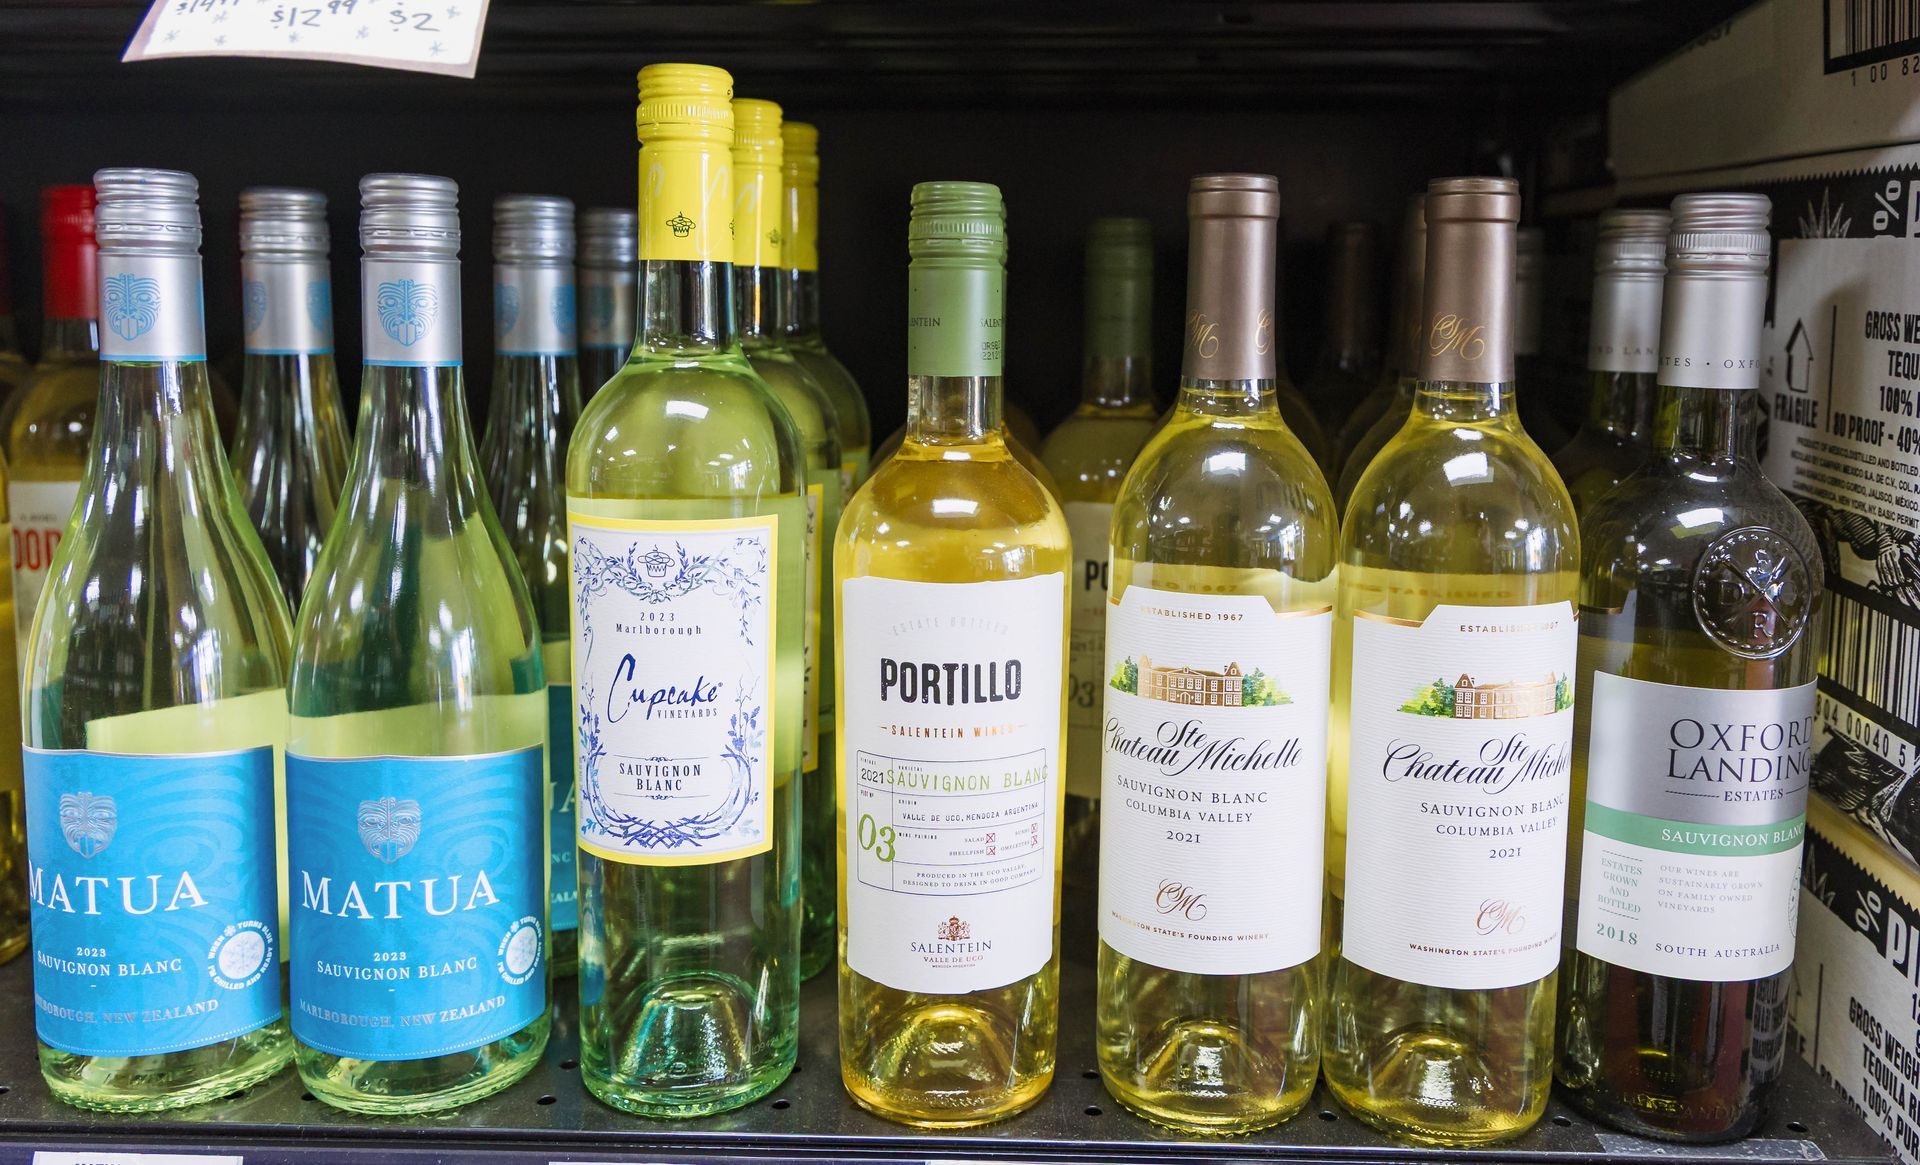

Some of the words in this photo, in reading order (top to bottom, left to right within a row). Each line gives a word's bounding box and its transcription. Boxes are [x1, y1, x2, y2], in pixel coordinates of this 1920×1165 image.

[1865, 310, 1901, 341] GROSS
[1775, 393, 1818, 428] FRAGILE
[1880, 386, 1912, 417] 100%
[1848, 415, 1885, 447] PROOF
[1878, 458, 1890, 469] AND
[1890, 460, 1918, 477] BOTTLED
[1876, 474, 1884, 485] DE
[1878, 507, 1895, 521] BASIC
[1896, 510, 1920, 530] PERMIT
[640, 612, 675, 621] 2023
[616, 624, 702, 635] Marlborough
[881, 658, 1021, 706] PORTILLO
[657, 708, 718, 719] VINEYARDS
[891, 725, 964, 738] SALENTEIN
[1104, 712, 1180, 766] Chateau
[1157, 719, 1207, 749] Ste
[1670, 716, 1812, 753] OXFORD
[1846, 711, 1890, 758] 00040
[1899, 744, 1907, 767] 5
[1160, 737, 1303, 776] Michelle
[1383, 738, 1504, 785] Chateau
[1480, 732, 1530, 766] Ste
[1667, 747, 1811, 783] LANDING
[619, 763, 701, 777] SAUVIGNON
[861, 768, 884, 784] 2021
[887, 768, 990, 792] SAUVIGNON
[1003, 765, 1048, 789] BLANC
[636, 779, 683, 791] BLANC
[1117, 775, 1203, 803] SAUVIGNON
[1211, 792, 1268, 804] BLANC
[1724, 788, 1784, 802] ESTATES
[903, 813, 925, 821] VALLE
[1004, 802, 1038, 816] ARGENTINA
[1126, 798, 1191, 820] COLUMBIA
[1198, 812, 1253, 823] VALLEY
[1420, 802, 1524, 818] SAUVIGNON
[1436, 825, 1514, 836] COLUMBIA
[1520, 817, 1557, 833] VALLEY
[858, 814, 896, 862] 03
[1166, 830, 1201, 843] 2021
[1661, 828, 1768, 847] SAUVIGNON
[1489, 847, 1522, 859] 2021
[1600, 858, 1643, 876] ESTATES
[1660, 864, 1682, 874] OUR
[1685, 868, 1718, 877] WINES
[28, 860, 209, 915] MATUA
[903, 879, 939, 887] DESIGNED
[1602, 871, 1639, 888] GROWN
[1658, 877, 1728, 889] SUSTAINABLY
[1731, 881, 1764, 889] GROWN
[301, 870, 500, 919] MATUA
[1609, 887, 1630, 898] AND
[1658, 889, 1674, 897] ON
[1677, 892, 1716, 902] FAMILY
[1719, 894, 1754, 902] OWNED
[1597, 894, 1641, 913] BOTTLED
[1657, 901, 1716, 914] VINEYARDS
[1153, 927, 1185, 938] STATE'S
[1188, 933, 1233, 941] FOUNDING
[1596, 922, 1638, 946] 2018
[76, 947, 106, 957] 2023
[911, 940, 992, 953] SALENTEIN
[1409, 943, 1469, 956] WASHINGTON
[1655, 942, 1707, 957] SOUTH
[1714, 943, 1780, 958] AUSTRALIA
[38, 950, 110, 976] SAUVIGNON
[118, 959, 183, 977] BLANC
[373, 952, 407, 962] 2023
[317, 960, 410, 980] SAUVIGNON
[418, 956, 478, 978] BLANC
[103, 1012, 137, 1024] NEW
[142, 999, 219, 1022] ZEALAND
[400, 1013, 436, 1027] NEW
[440, 994, 506, 1022] ZEALAND
[1849, 996, 1883, 1050] GROSS
[1862, 1043, 1905, 1111] TEQUILA
[1863, 1077, 1893, 1131] 100%
